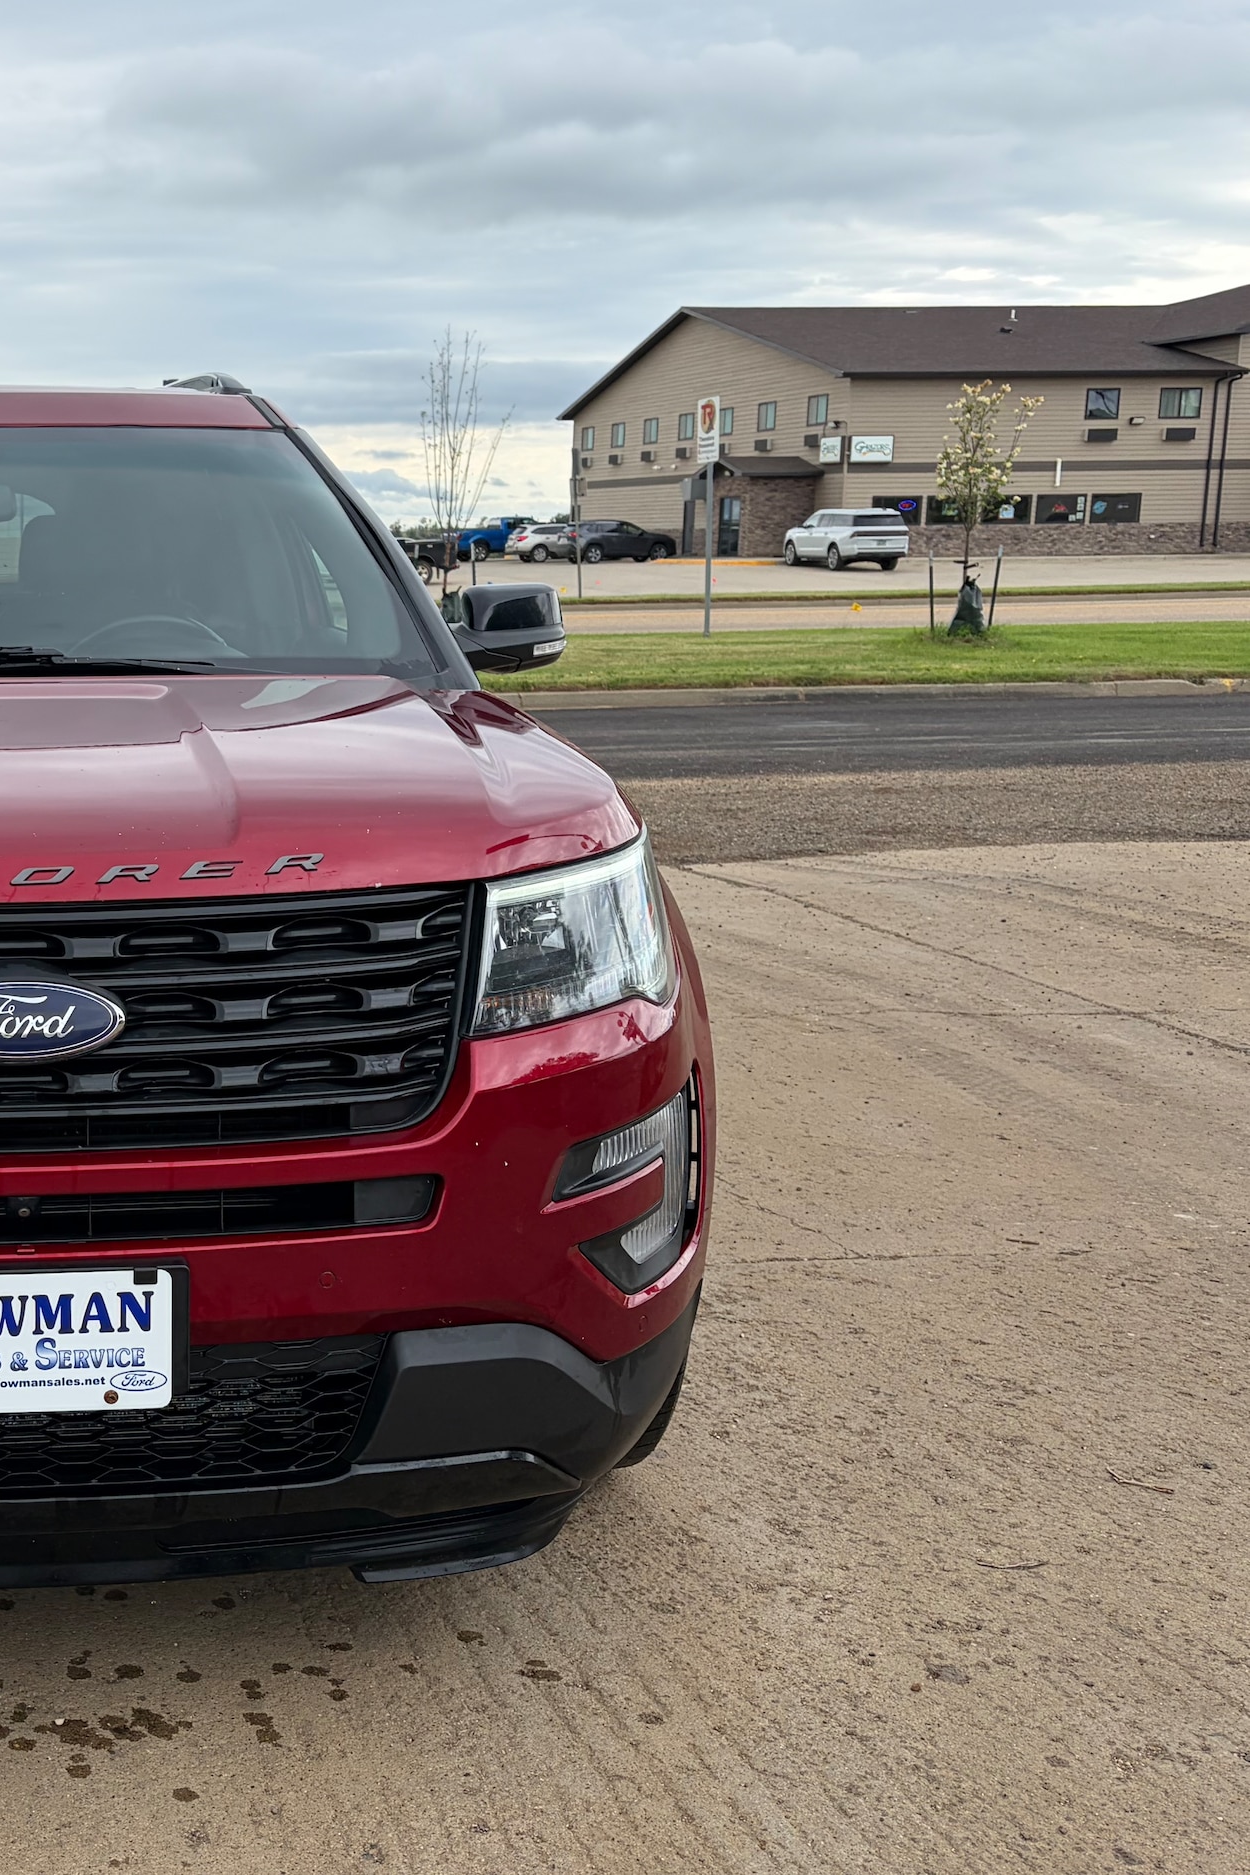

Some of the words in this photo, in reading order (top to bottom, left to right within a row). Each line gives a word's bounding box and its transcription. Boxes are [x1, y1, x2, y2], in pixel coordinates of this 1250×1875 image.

[9, 1350, 29, 1371] &
[35, 1337, 146, 1371] SERVICE
[120, 1373, 155, 1388] Ford
